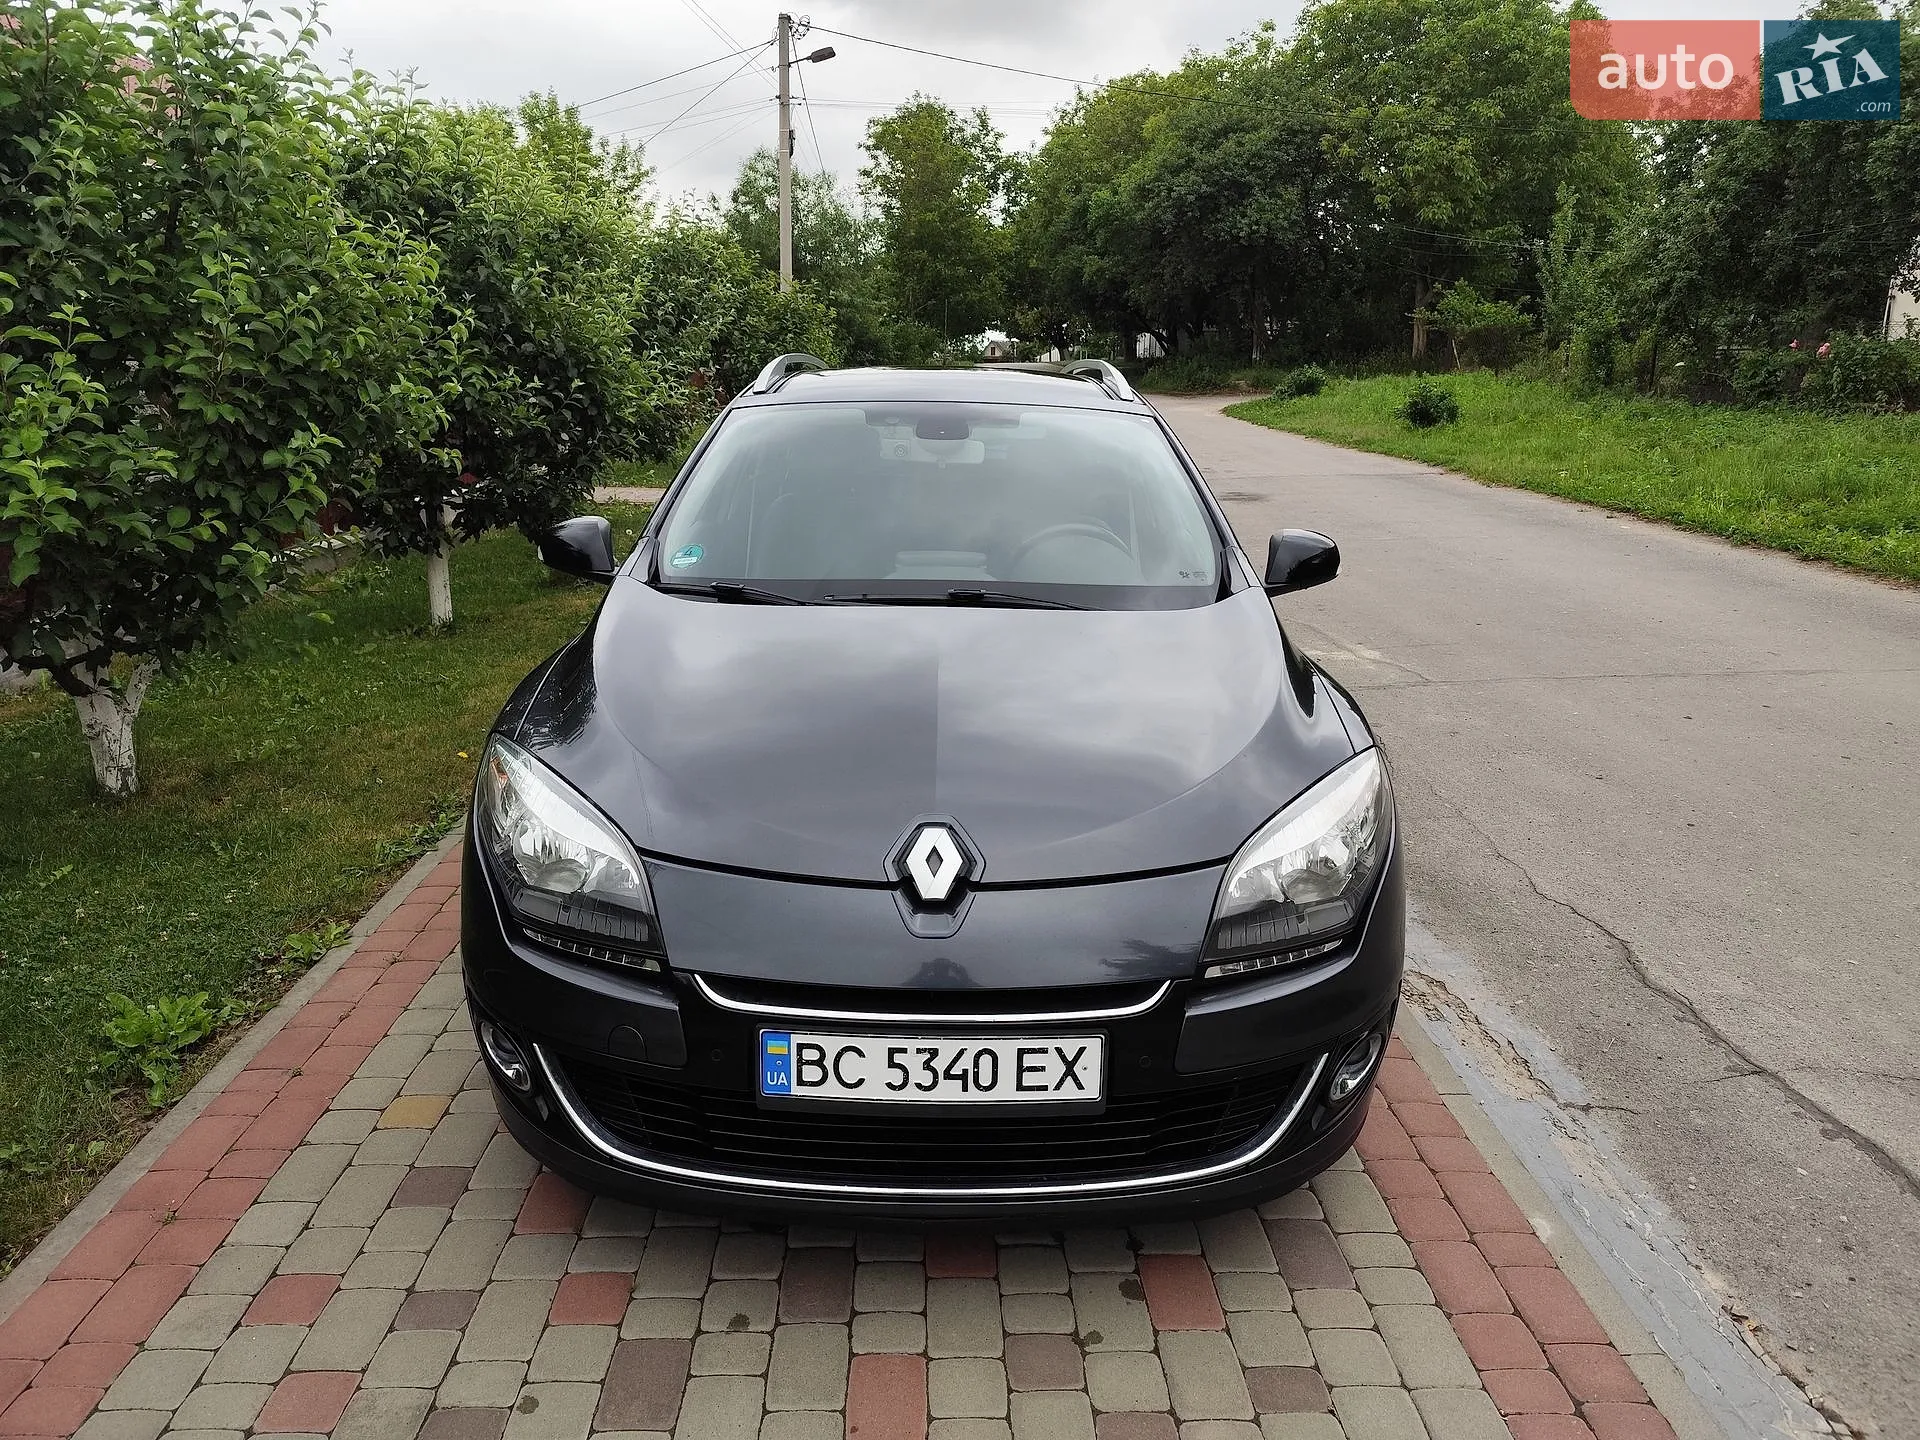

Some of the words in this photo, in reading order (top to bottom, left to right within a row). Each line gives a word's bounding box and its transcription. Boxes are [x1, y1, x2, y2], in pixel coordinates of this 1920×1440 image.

[767, 1071, 789, 1086] UA
[795, 1042, 866, 1089] BC
[884, 1047, 999, 1093] 5340
[1015, 1046, 1088, 1092] EX
